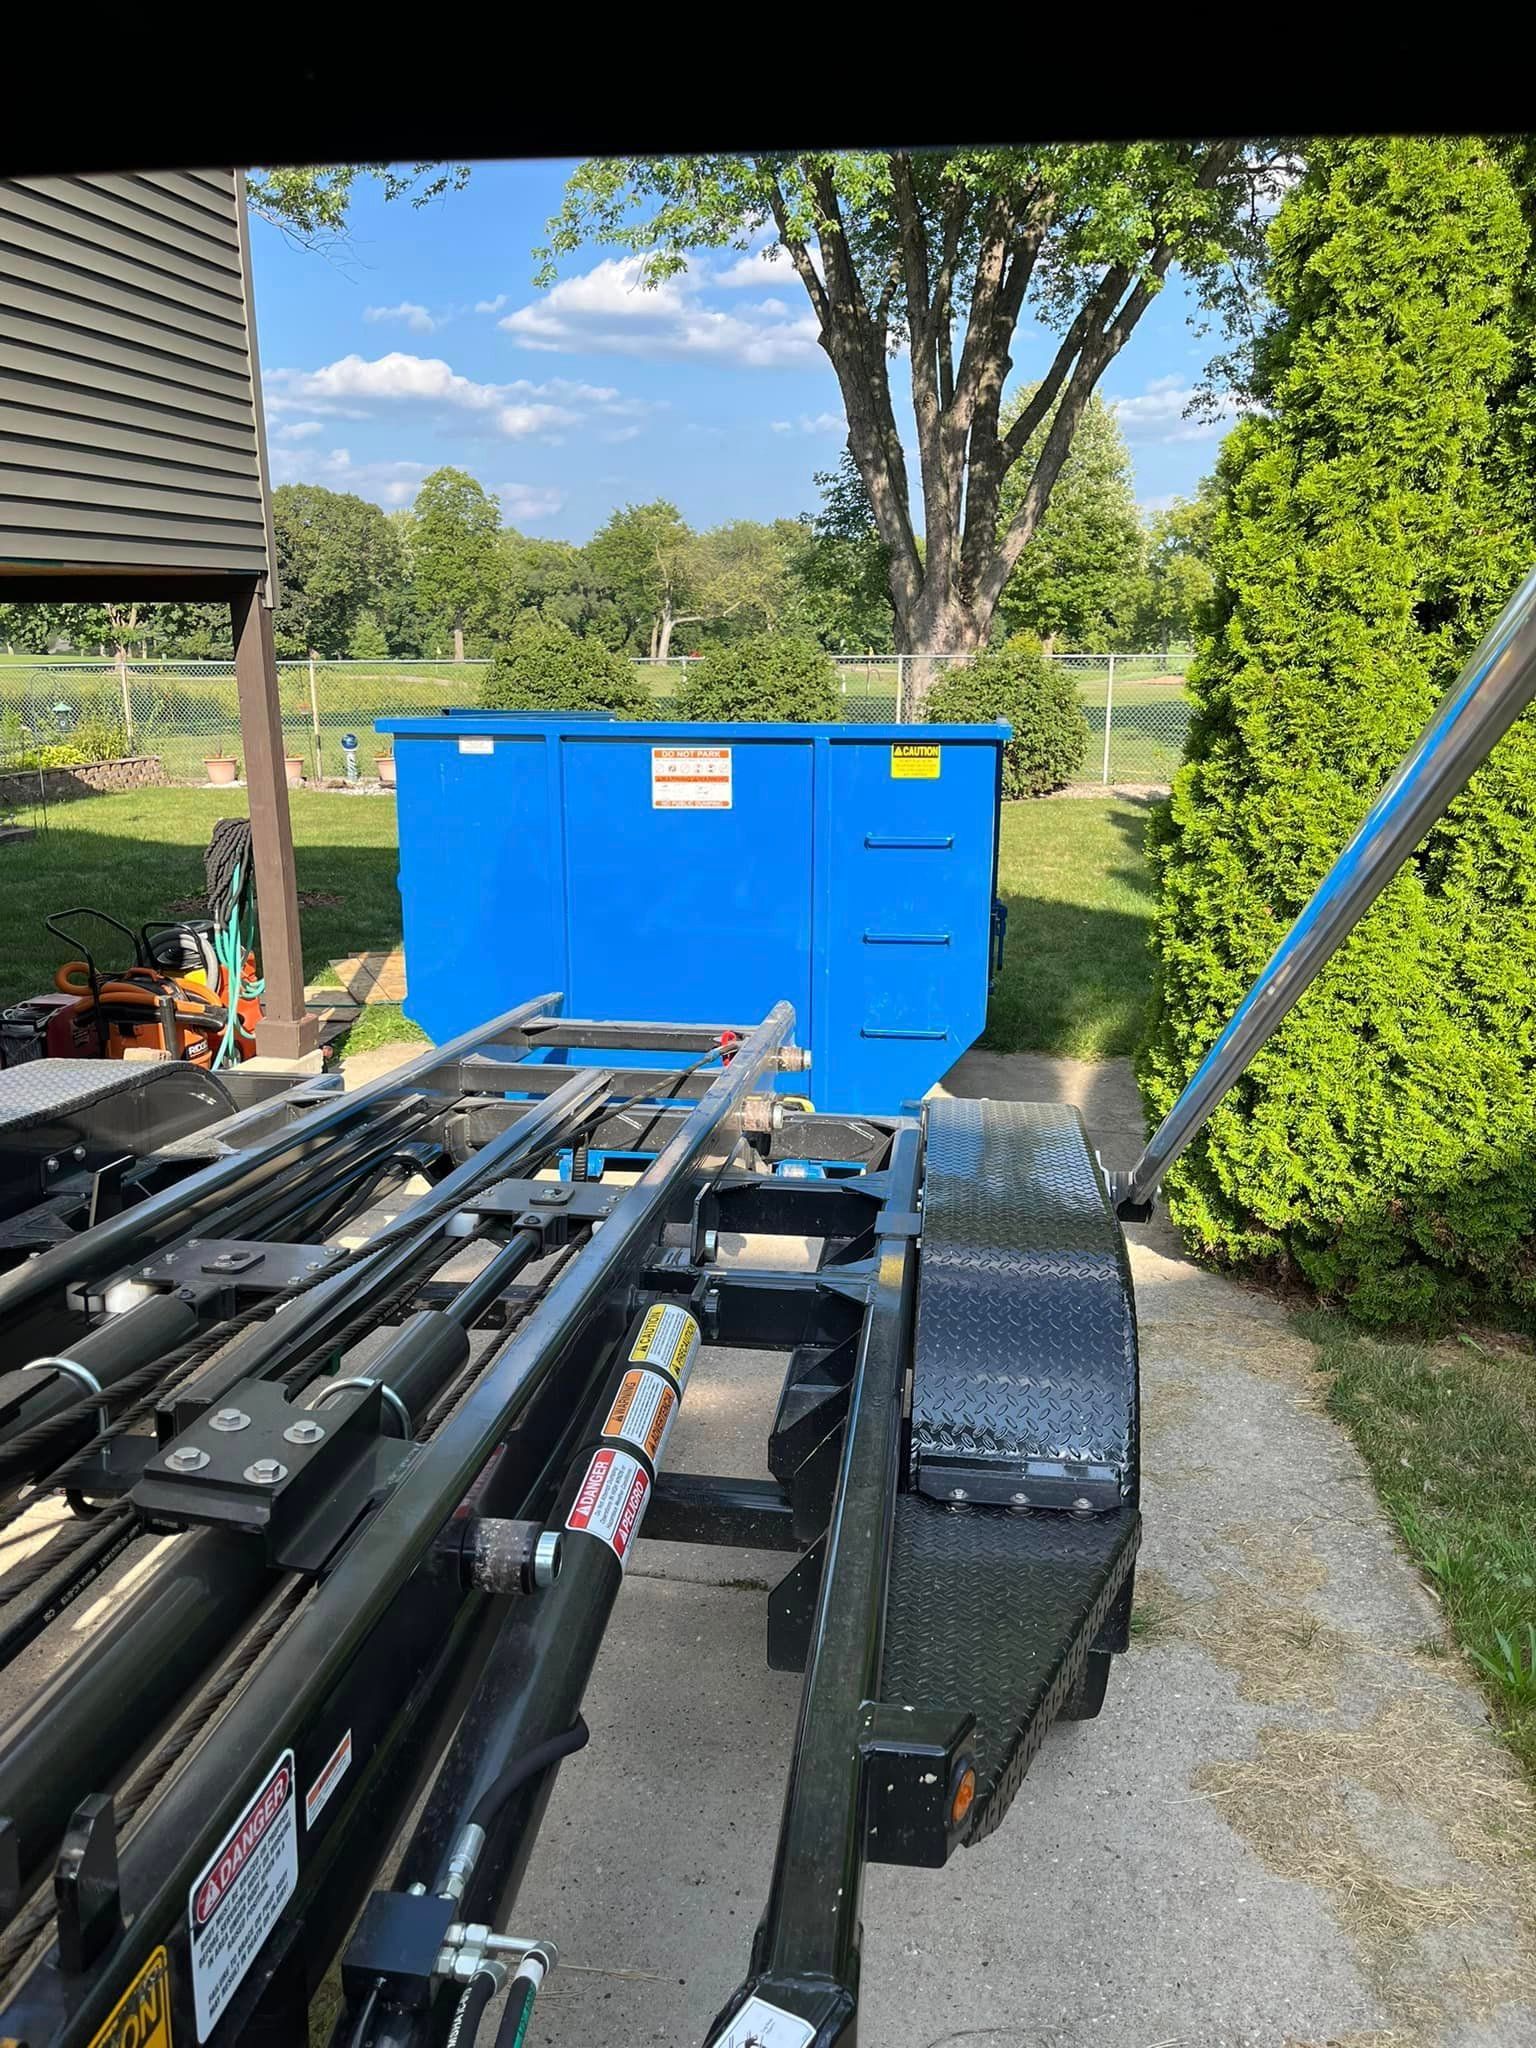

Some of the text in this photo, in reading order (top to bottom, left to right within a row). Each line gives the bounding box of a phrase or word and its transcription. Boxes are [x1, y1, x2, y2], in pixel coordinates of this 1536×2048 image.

[903, 746, 938, 756] CAUTION
[640, 1311, 661, 1346] CAUTION
[676, 1320, 696, 1366] PRECAUTION
[614, 1381, 636, 1417] WARNING
[579, 1461, 608, 1508] DANGER
[623, 1481, 644, 1533] PELIGRO
[219, 1778, 284, 1889] DANGER
